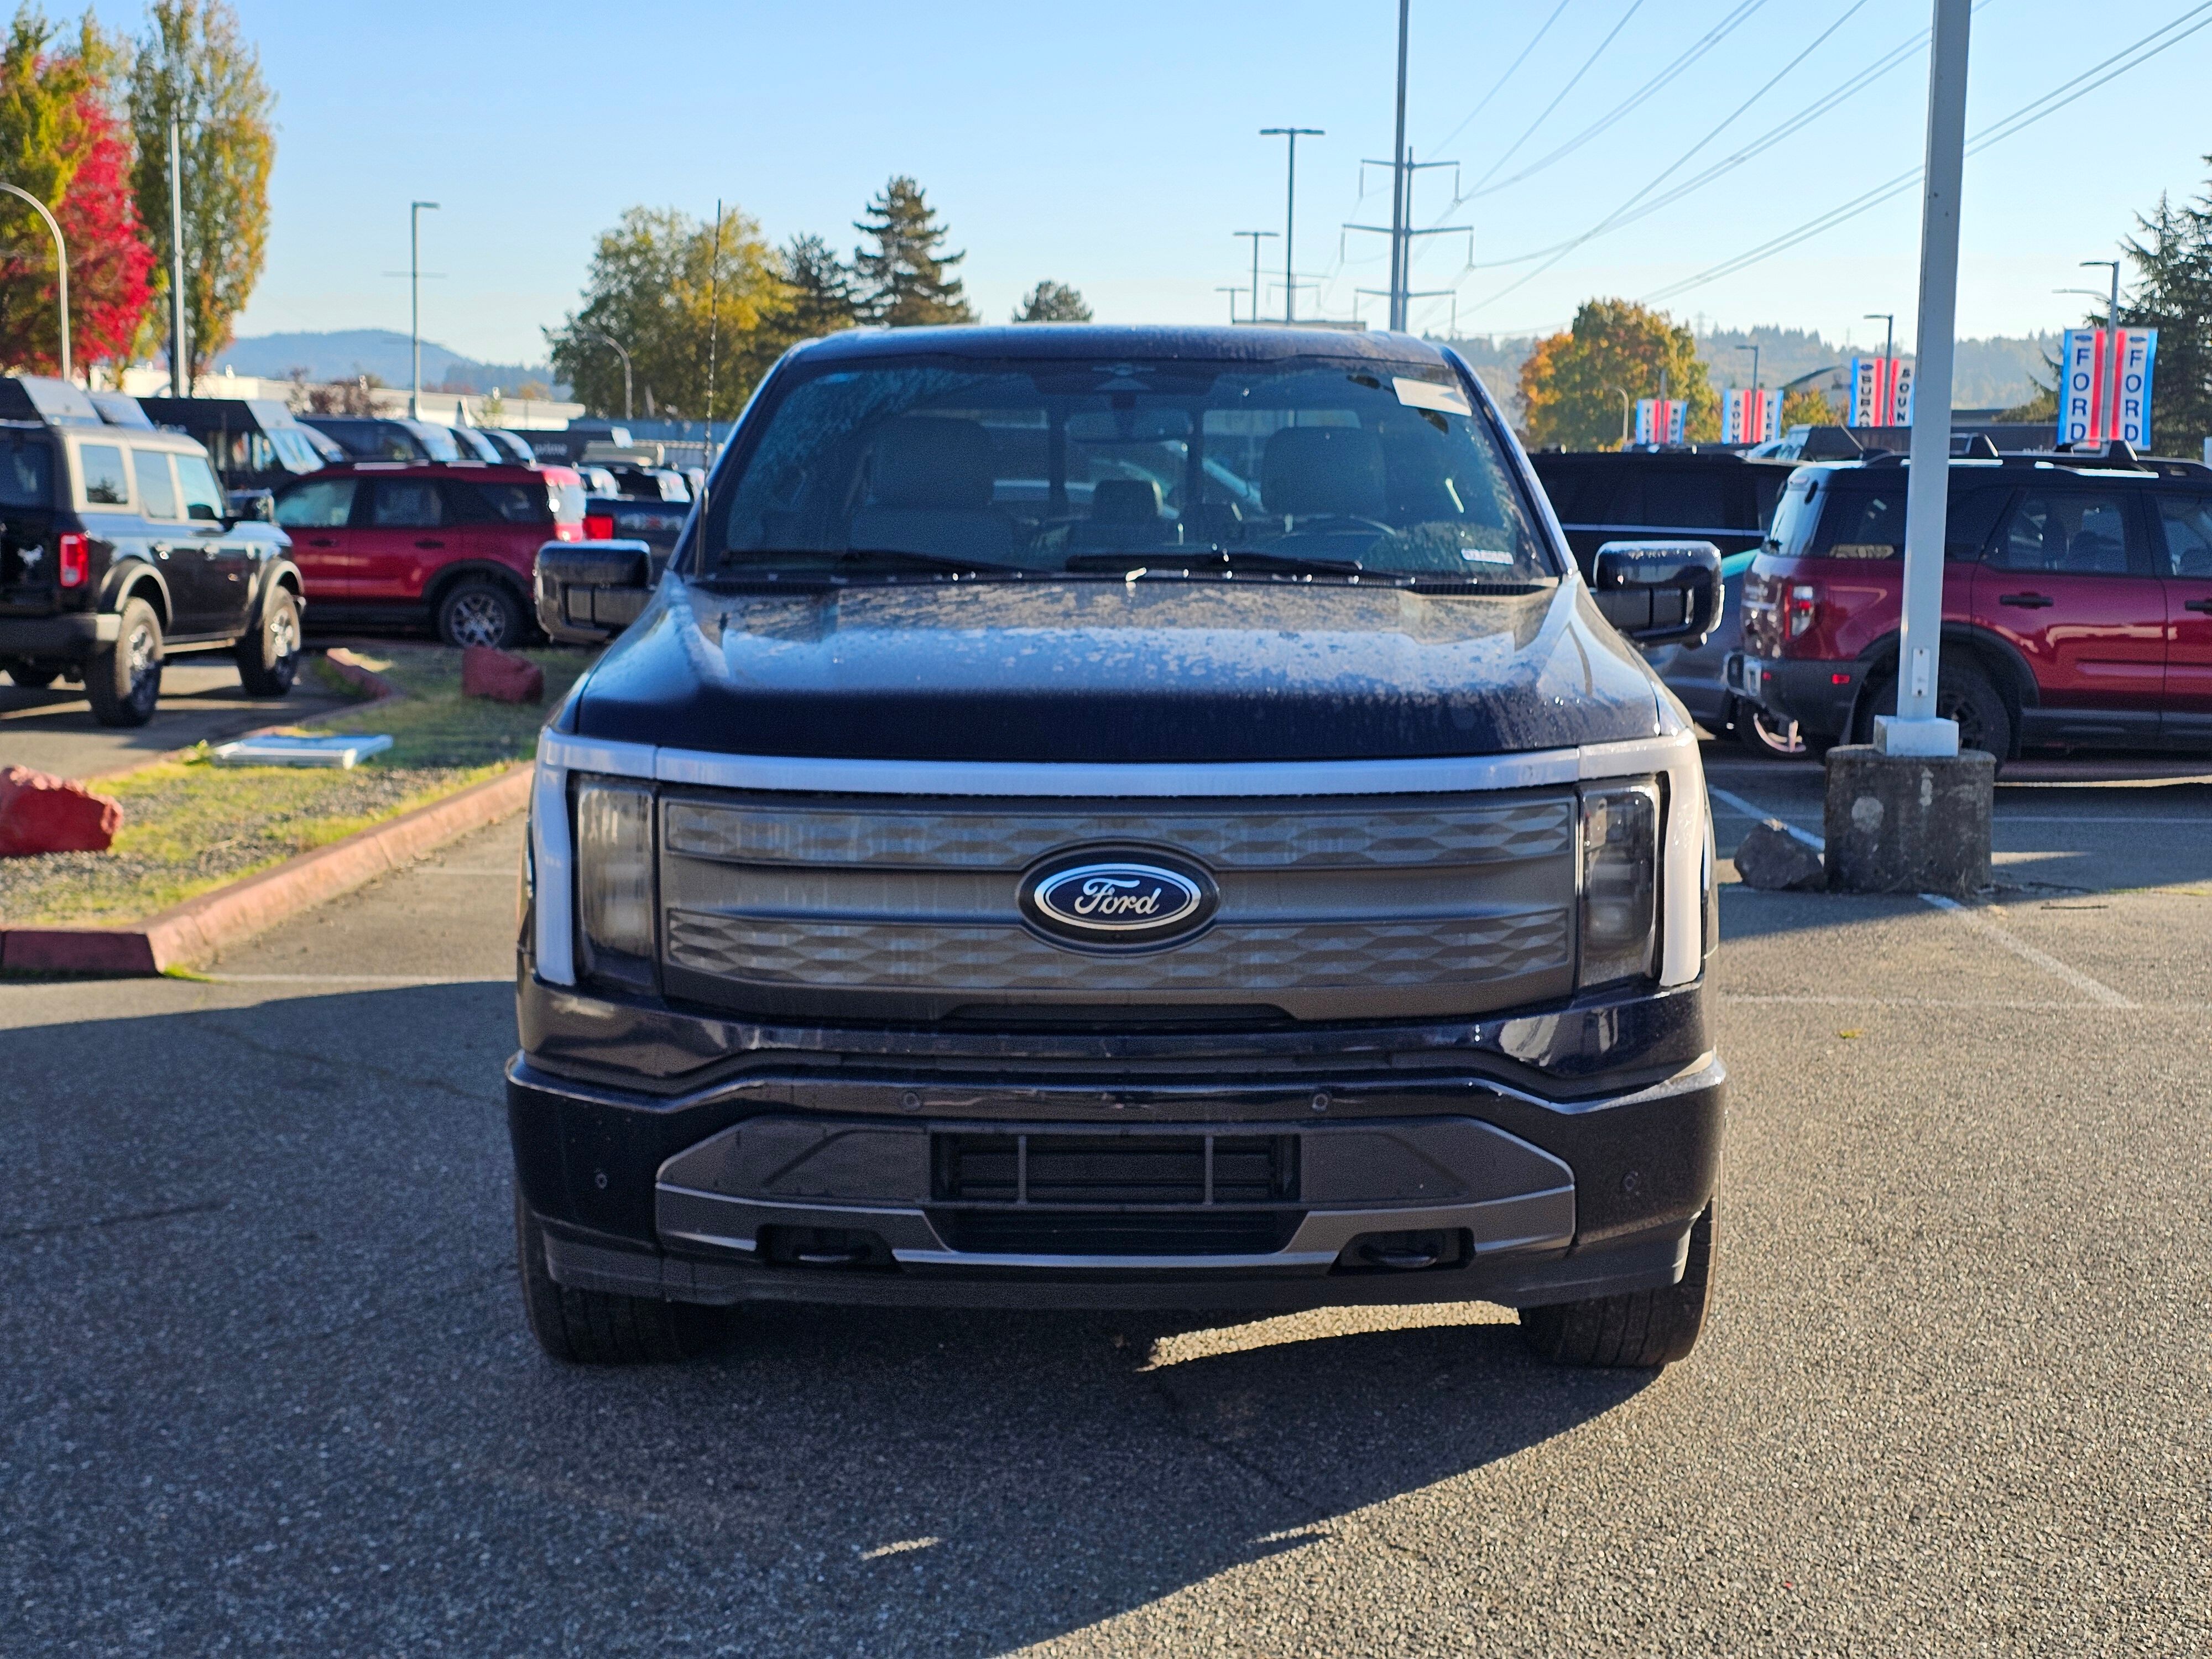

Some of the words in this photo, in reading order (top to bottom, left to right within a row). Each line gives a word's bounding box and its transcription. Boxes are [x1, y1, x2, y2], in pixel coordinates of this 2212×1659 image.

[2070, 348, 2091, 441] FORD
[2125, 349, 2143, 441] FORD
[1074, 878, 1160, 915] Ford
